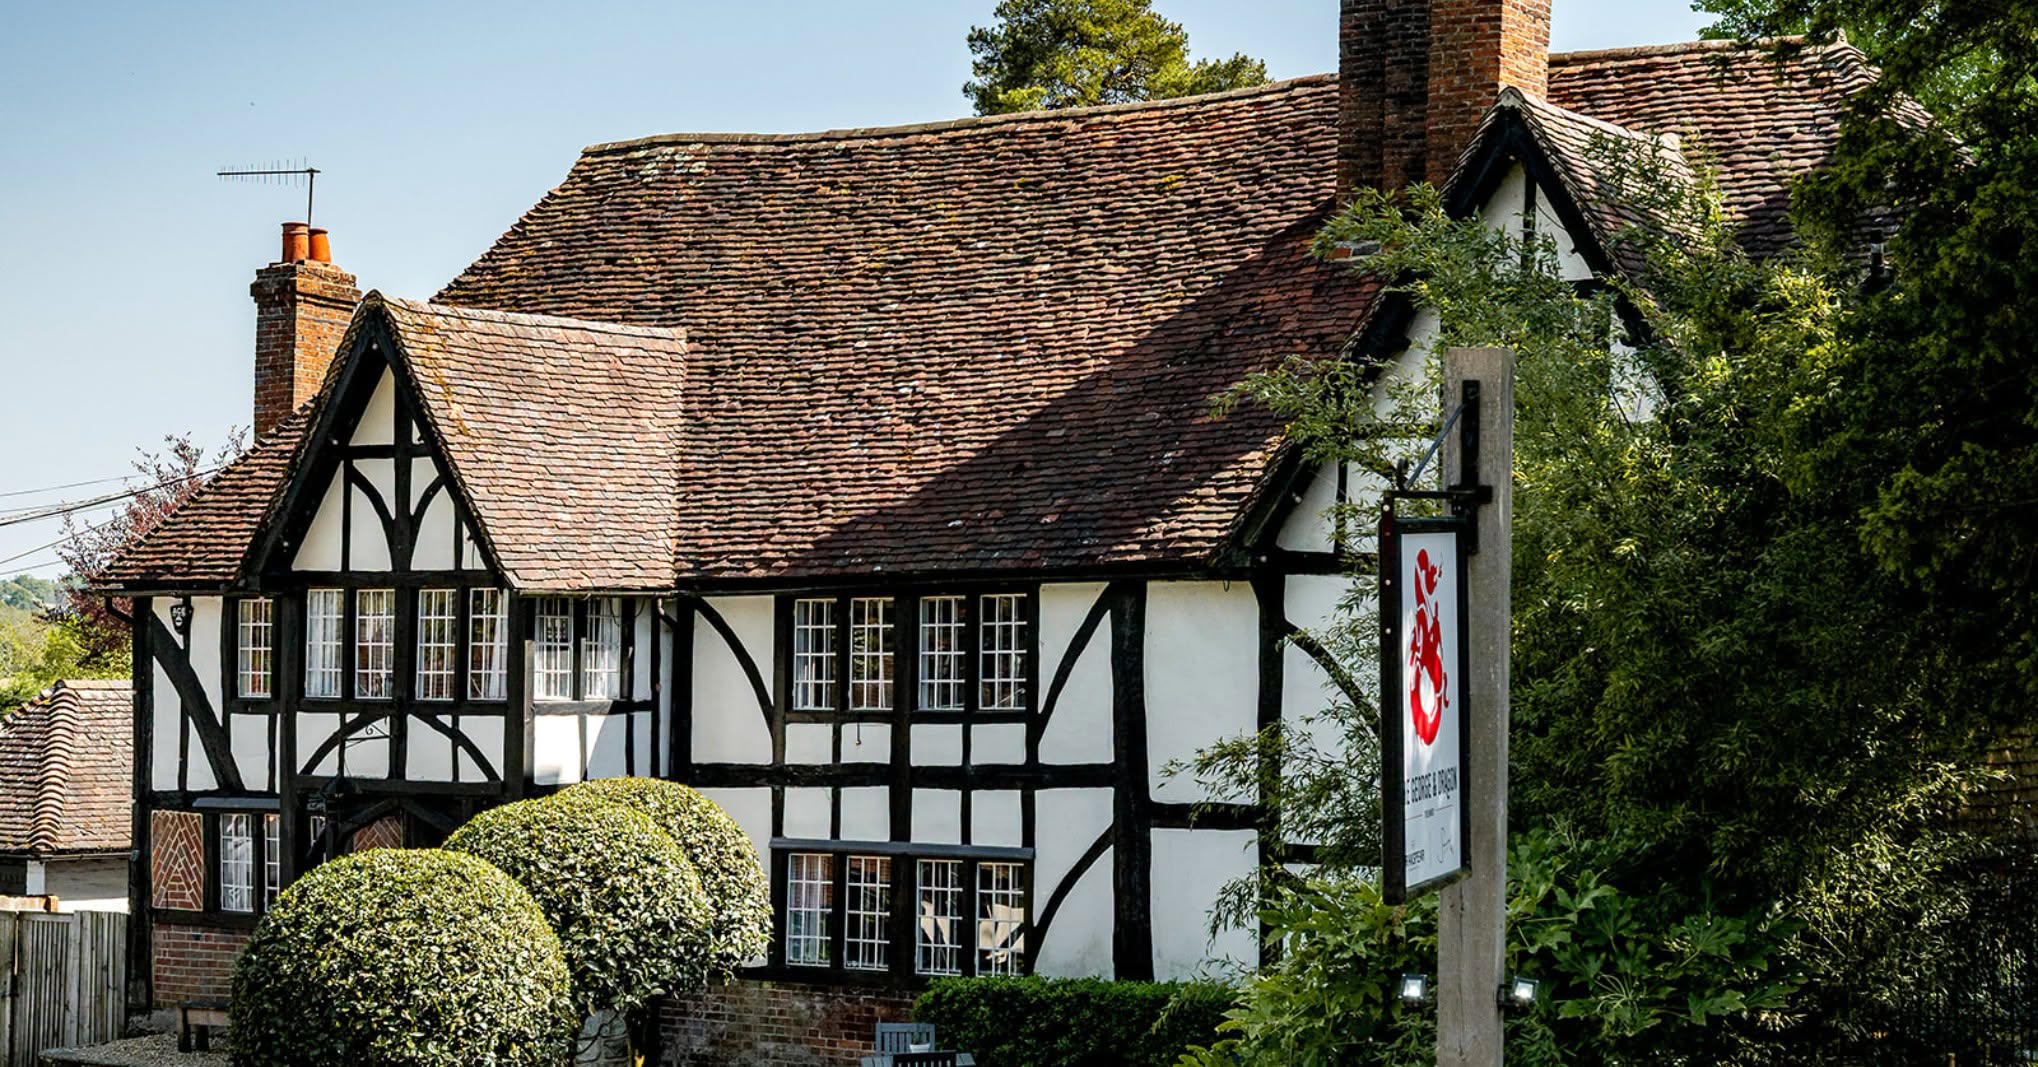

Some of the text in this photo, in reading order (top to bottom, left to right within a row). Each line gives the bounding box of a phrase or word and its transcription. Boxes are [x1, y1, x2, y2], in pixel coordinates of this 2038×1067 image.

[1411, 773, 1431, 804] GEORGE
[1432, 771, 1437, 797] &
[1438, 766, 1457, 800] DRAGON
